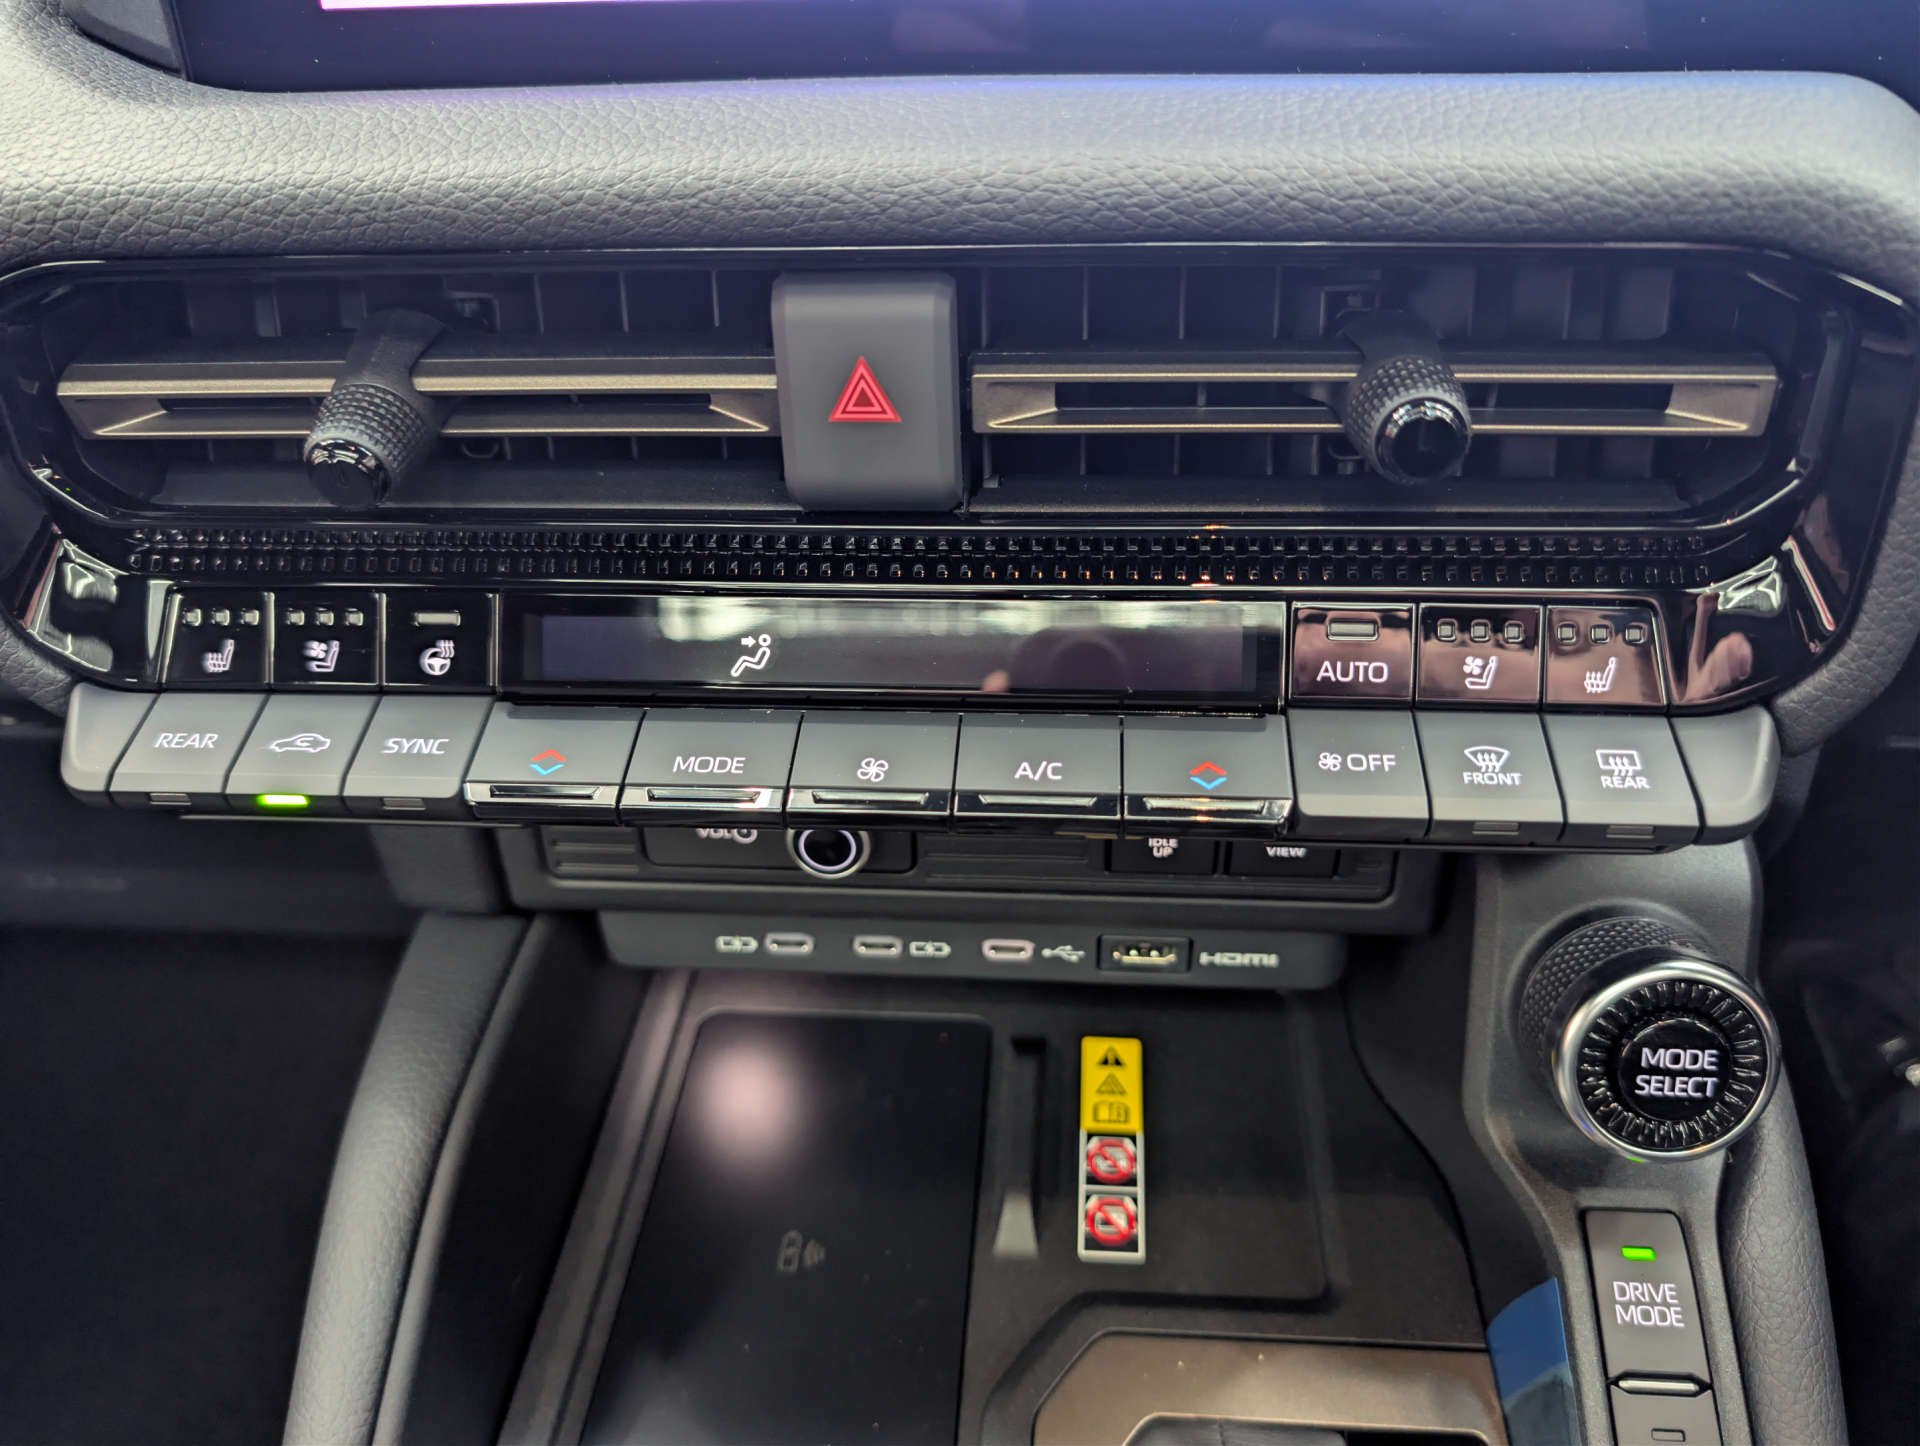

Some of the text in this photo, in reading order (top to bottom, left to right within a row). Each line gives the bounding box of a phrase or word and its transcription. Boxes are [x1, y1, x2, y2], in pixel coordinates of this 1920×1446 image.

[1316, 660, 1389, 683] AUTO
[153, 732, 218, 750] REAR
[383, 737, 450, 756] SYNC
[672, 756, 745, 774] MODE
[1014, 761, 1064, 781] A/C
[1347, 753, 1396, 772] OFF
[1463, 772, 1522, 786] FRONT
[1600, 775, 1650, 790] REAR
[1148, 838, 1178, 848] IDLE
[1152, 847, 1174, 858] UP
[1265, 846, 1307, 858] VIEW
[1641, 1047, 1718, 1070] MODE
[1635, 1075, 1719, 1099] SELECT
[1613, 1281, 1678, 1305] DRIVE
[1616, 1304, 1685, 1328] MODE
